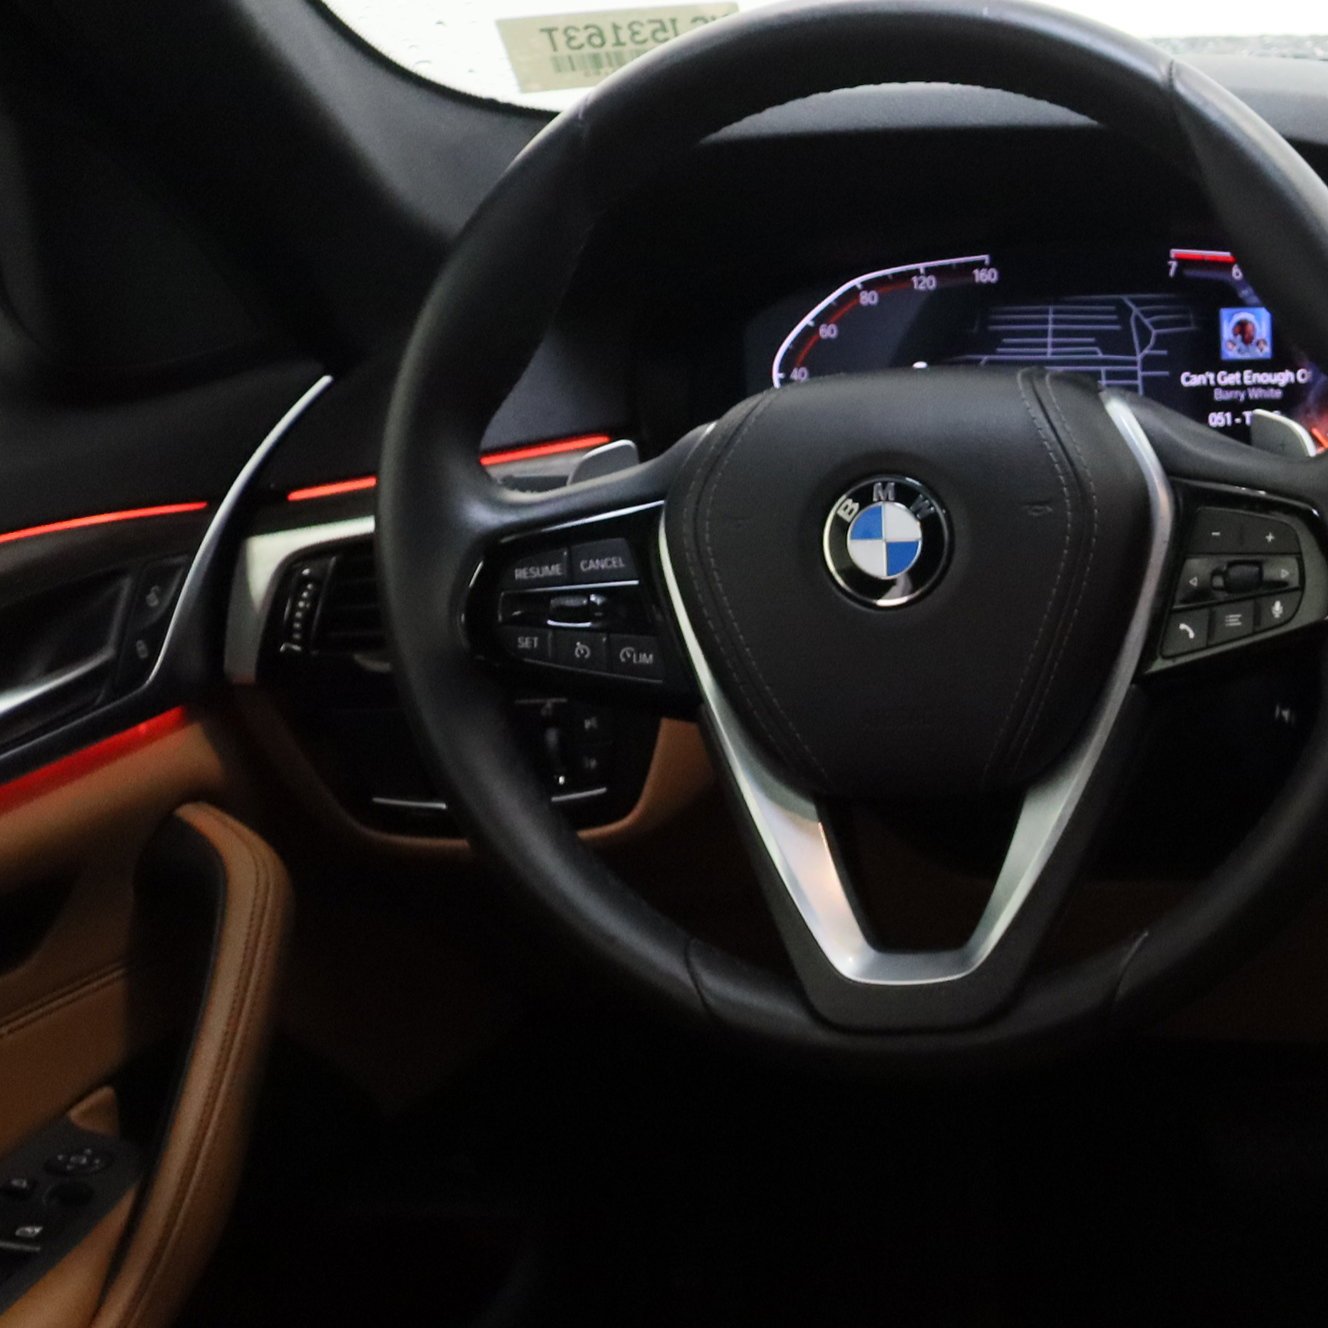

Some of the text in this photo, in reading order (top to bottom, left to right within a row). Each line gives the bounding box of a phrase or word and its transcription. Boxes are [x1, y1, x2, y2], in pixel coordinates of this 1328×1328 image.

[973, 267, 998, 283] 160
[1167, 260, 1178, 278] 7
[1231, 263, 1243, 280] 6
[911, 275, 937, 290] 120
[859, 290, 878, 306] 80
[819, 323, 838, 339] 60
[790, 367, 809, 382] 40
[1180, 371, 1216, 387] Can't
[1217, 371, 1242, 386] Get
[1243, 369, 1294, 388] Enough
[1213, 387, 1282, 401] Barry White
[1208, 411, 1231, 428] 051
[837, 482, 935, 523] BMW
[514, 564, 563, 580] RESUME
[580, 556, 625, 572] CANCEL
[517, 636, 539, 649] SET
[632, 653, 654, 664] LIM
